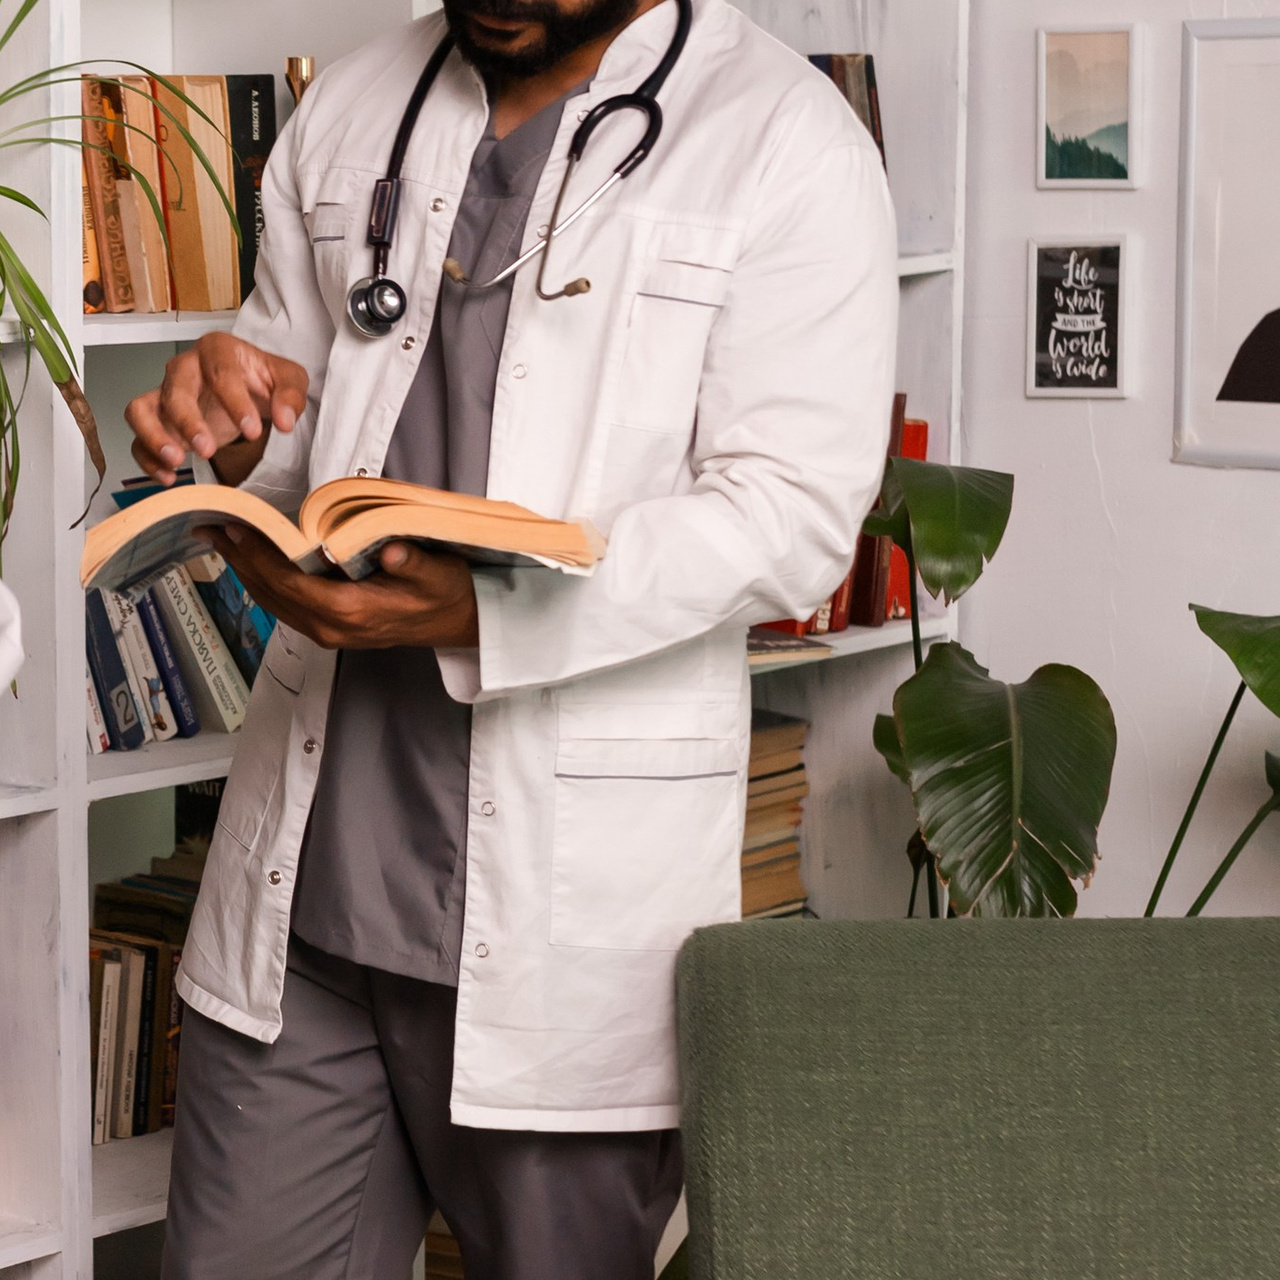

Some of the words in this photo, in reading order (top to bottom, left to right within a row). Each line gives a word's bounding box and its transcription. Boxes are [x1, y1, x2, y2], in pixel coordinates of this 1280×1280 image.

[1062, 249, 1098, 290] Life
[1054, 287, 1063, 307] is
[1066, 287, 1105, 315] short
[1061, 318, 1078, 327] AND
[1081, 317, 1096, 327] THE
[1048, 328, 1110, 359] World
[1052, 358, 1061, 378] is
[161, 571, 191, 616] СМЕР
[184, 615, 217, 675] ПЛЯСКА
